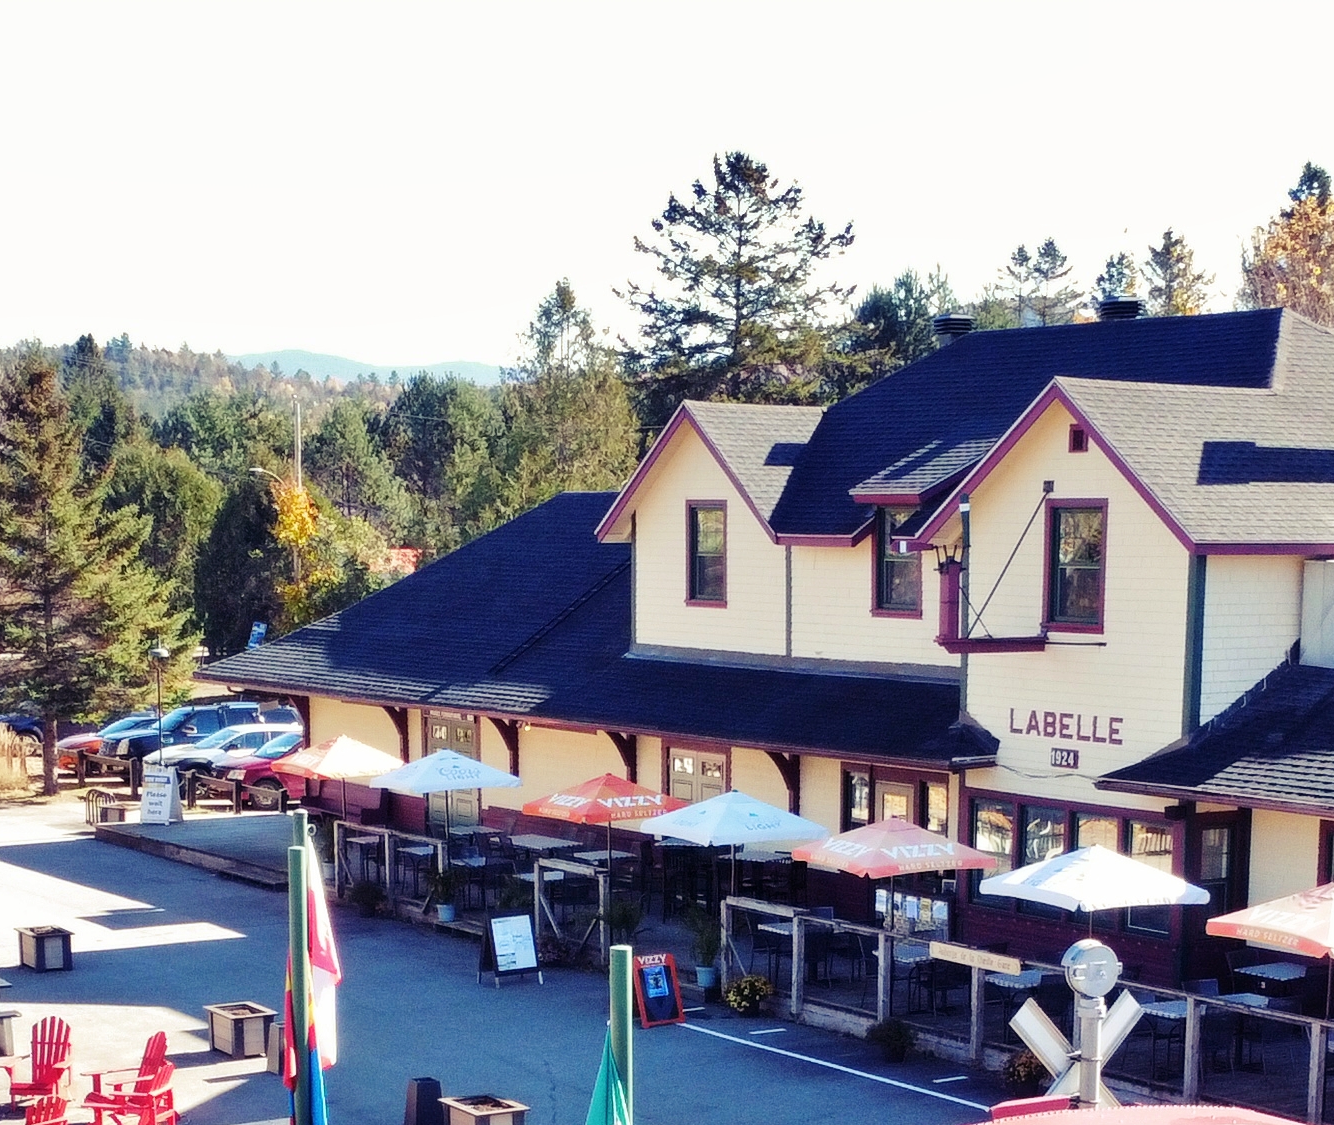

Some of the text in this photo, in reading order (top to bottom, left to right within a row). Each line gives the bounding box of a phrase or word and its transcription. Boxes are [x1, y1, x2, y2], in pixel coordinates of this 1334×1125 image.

[1009, 707, 1124, 745] LABELLE
[1051, 749, 1075, 767] 1924
[548, 793, 589, 809] VIZZY
[597, 794, 664, 808] VIZZY
[610, 811, 632, 819] HARD
[822, 837, 873, 858] VIZZY
[880, 843, 955, 859] VIZZY
[898, 859, 964, 872] HARD SELTZER
[1248, 907, 1327, 933] VIZZY
[1236, 927, 1300, 946] HARD SELTZER
[637, 954, 666, 965] VIZZY
